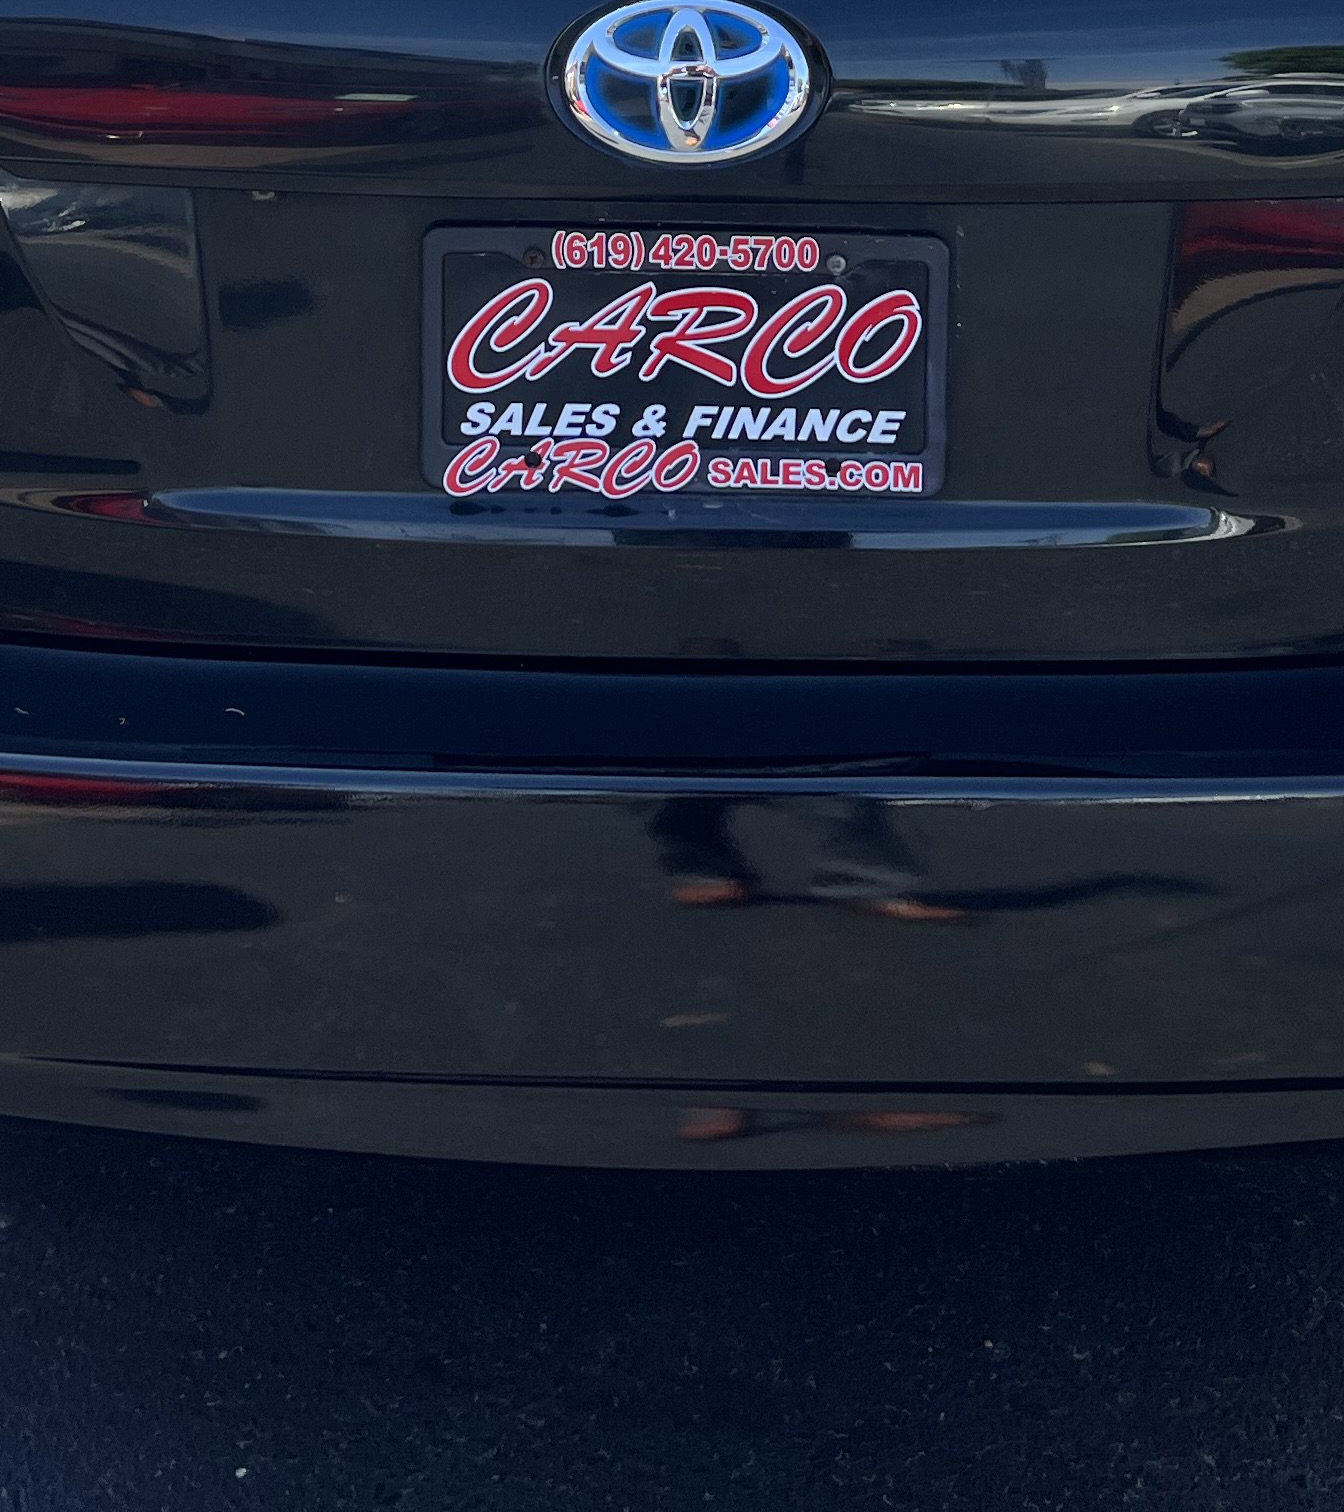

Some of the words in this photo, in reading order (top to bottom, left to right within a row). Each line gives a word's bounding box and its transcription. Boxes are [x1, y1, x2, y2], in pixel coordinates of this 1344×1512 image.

[551, 230, 645, 270] (619)
[649, 234, 821, 272] 420-5700
[447, 278, 923, 399] CARCO
[459, 401, 622, 439] SALES
[632, 404, 667, 438] &
[682, 406, 907, 444] FINANCE
[443, 436, 701, 499] CARCO
[708, 457, 923, 493] SALES.COM
